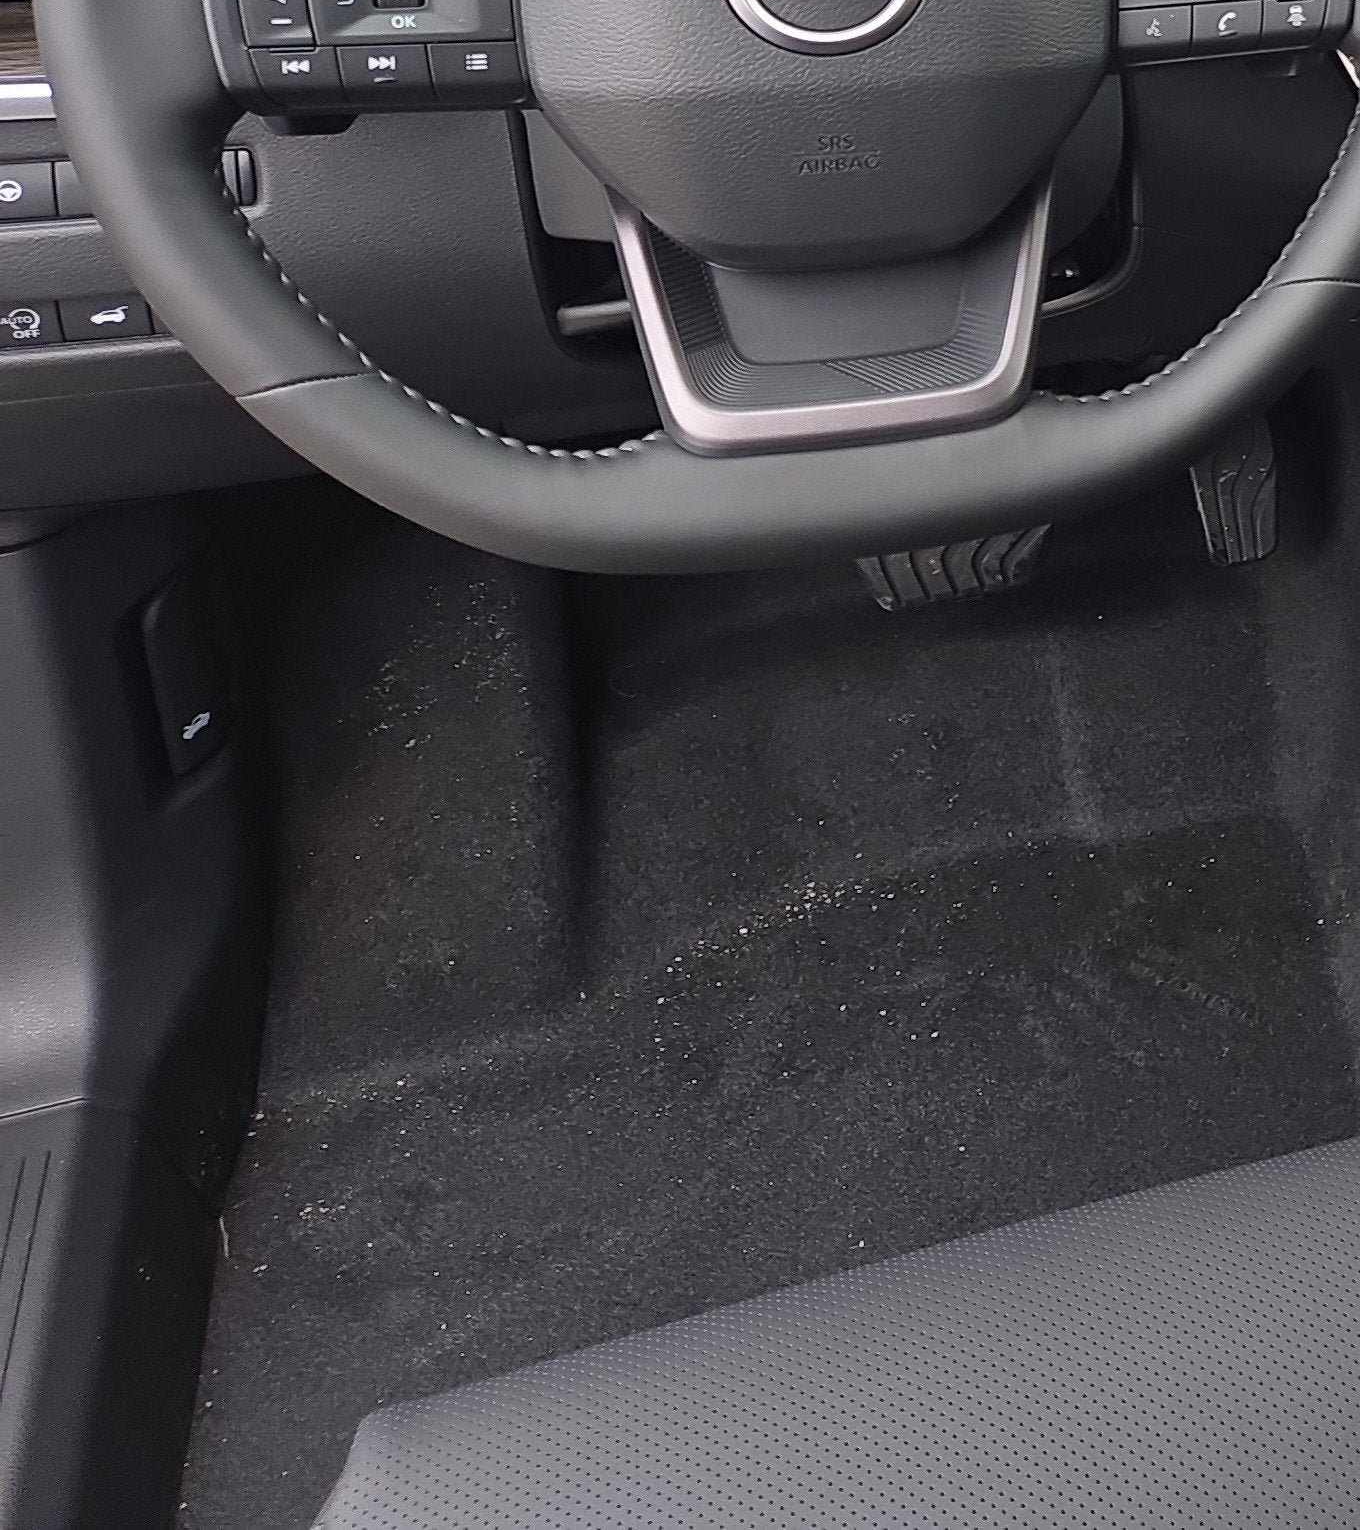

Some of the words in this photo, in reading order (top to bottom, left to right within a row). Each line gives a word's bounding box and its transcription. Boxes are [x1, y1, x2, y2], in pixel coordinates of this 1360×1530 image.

[390, 15, 417, 29] OK
[817, 134, 856, 151] SRS
[799, 152, 880, 174] AIRBAG
[12, 329, 40, 339] OFF
